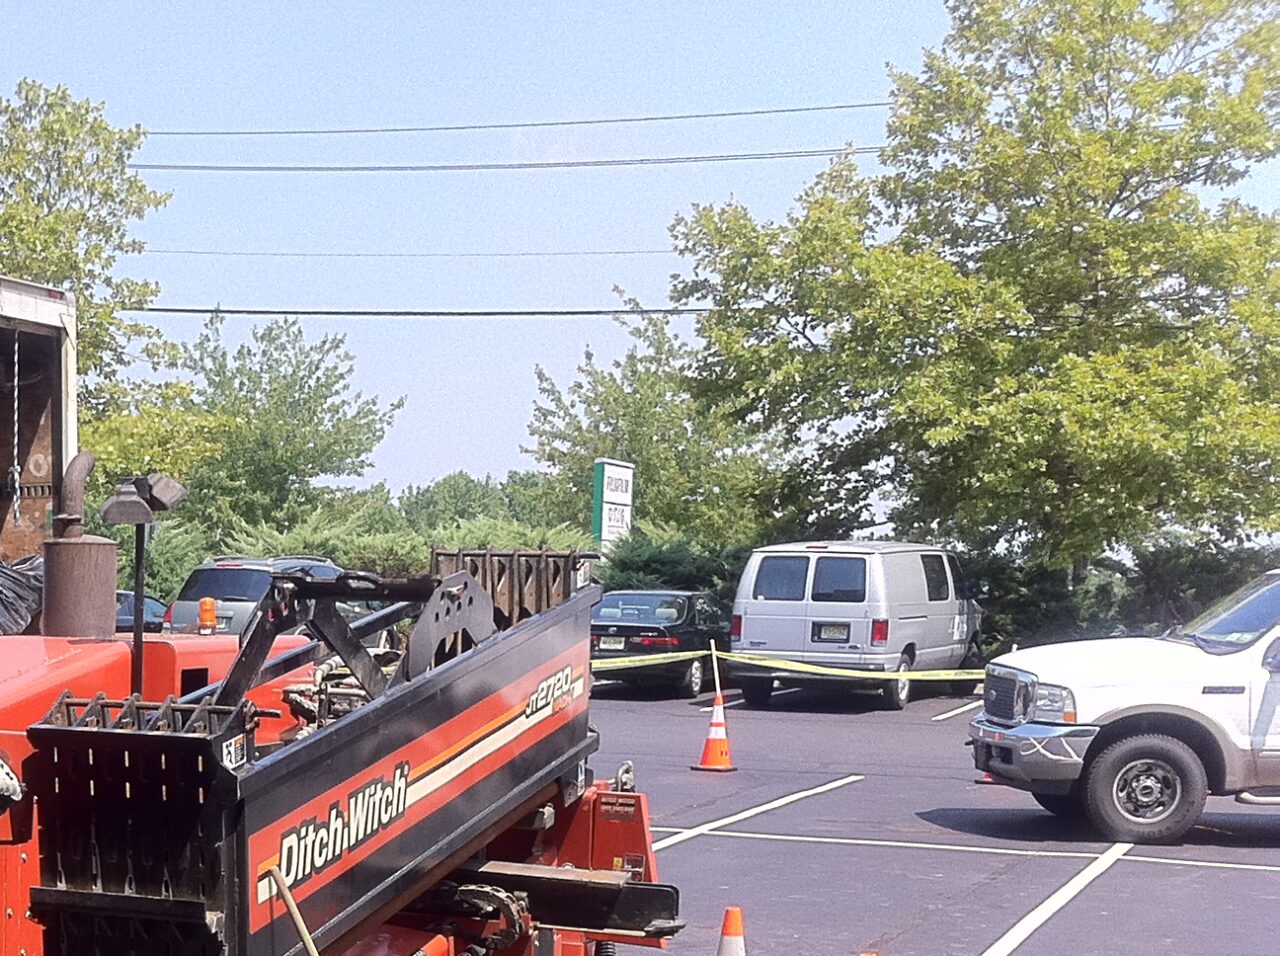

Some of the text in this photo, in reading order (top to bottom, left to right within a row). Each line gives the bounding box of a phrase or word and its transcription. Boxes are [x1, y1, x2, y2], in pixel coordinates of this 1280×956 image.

[524, 664, 573, 718] JT2720
[280, 766, 407, 887] Ditch Witch
